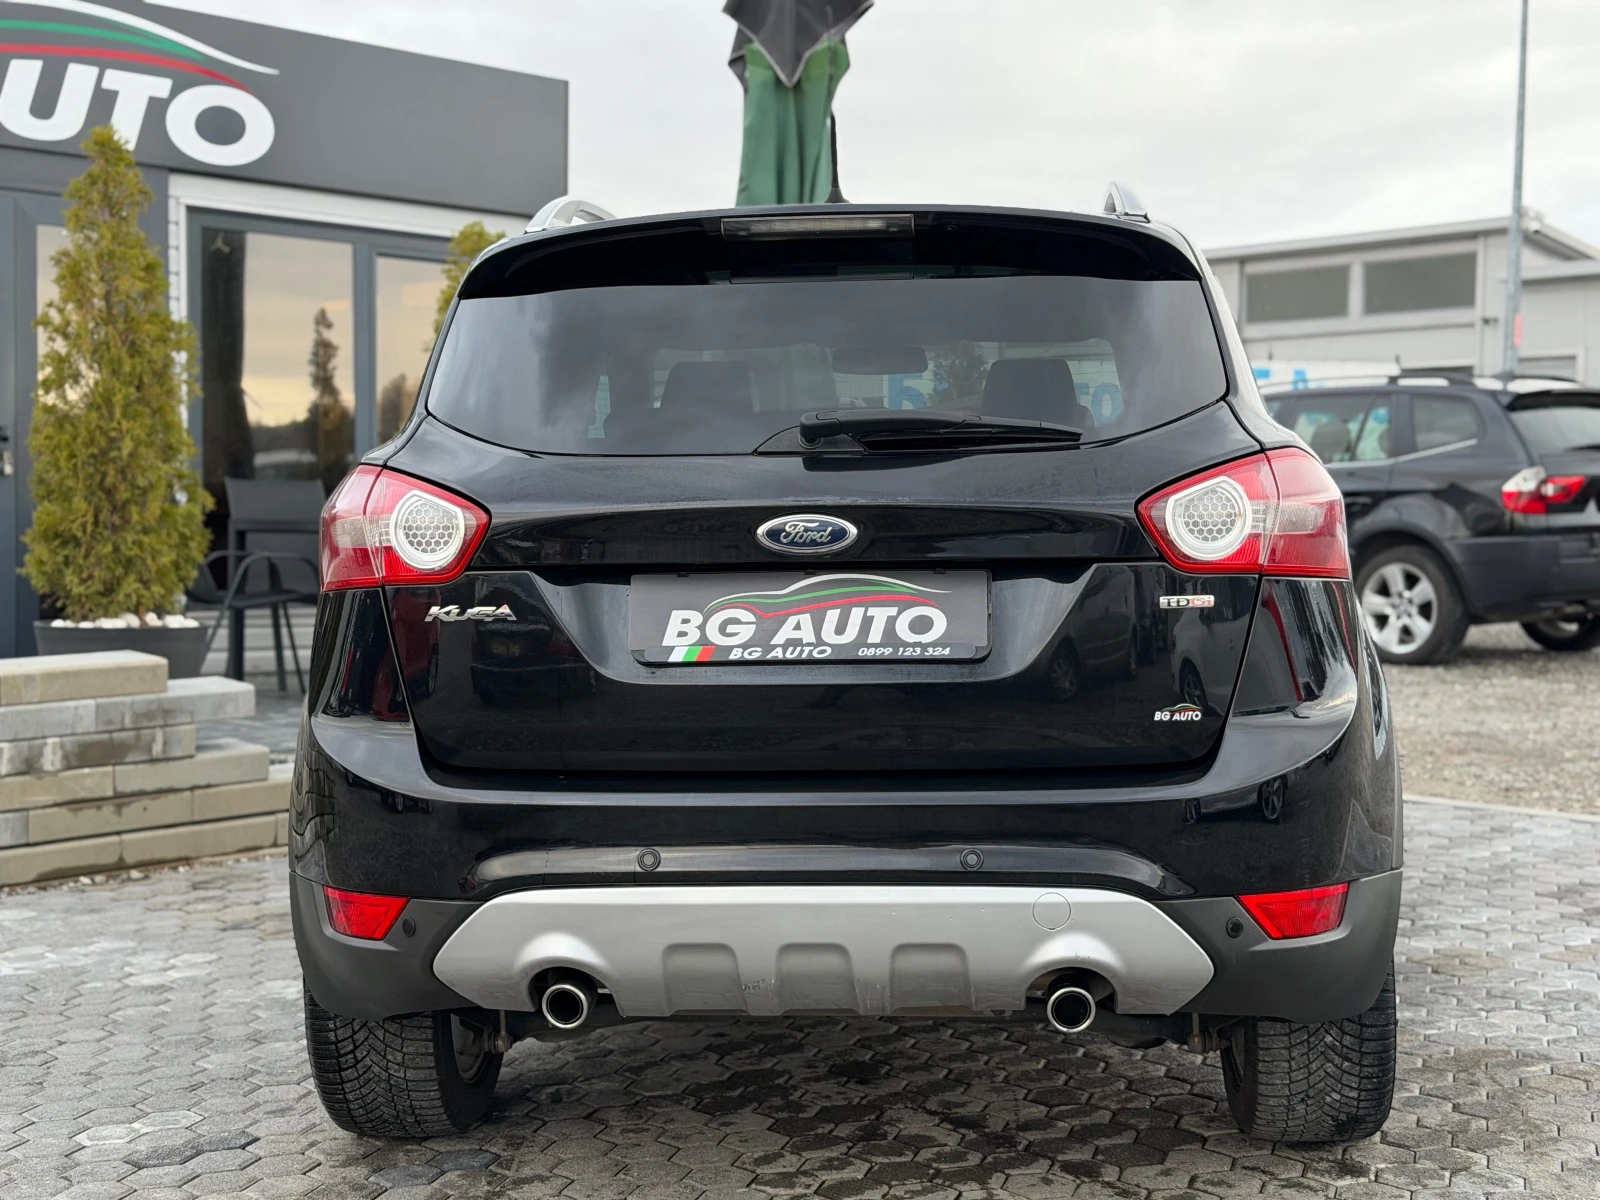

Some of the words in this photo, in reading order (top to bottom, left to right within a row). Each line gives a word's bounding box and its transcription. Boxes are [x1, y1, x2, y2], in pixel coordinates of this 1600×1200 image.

[780, 521, 833, 544] Ford
[1162, 597, 1212, 608] TDCi
[661, 608, 756, 646] BG
[769, 606, 947, 645] AUTO
[728, 647, 763, 659] BG
[765, 646, 832, 658] AUTO
[857, 647, 893, 656] 0899
[897, 647, 921, 656] 123
[923, 646, 951, 656] 324
[1154, 711, 1171, 721] BG
[1172, 711, 1202, 721] AUTO
